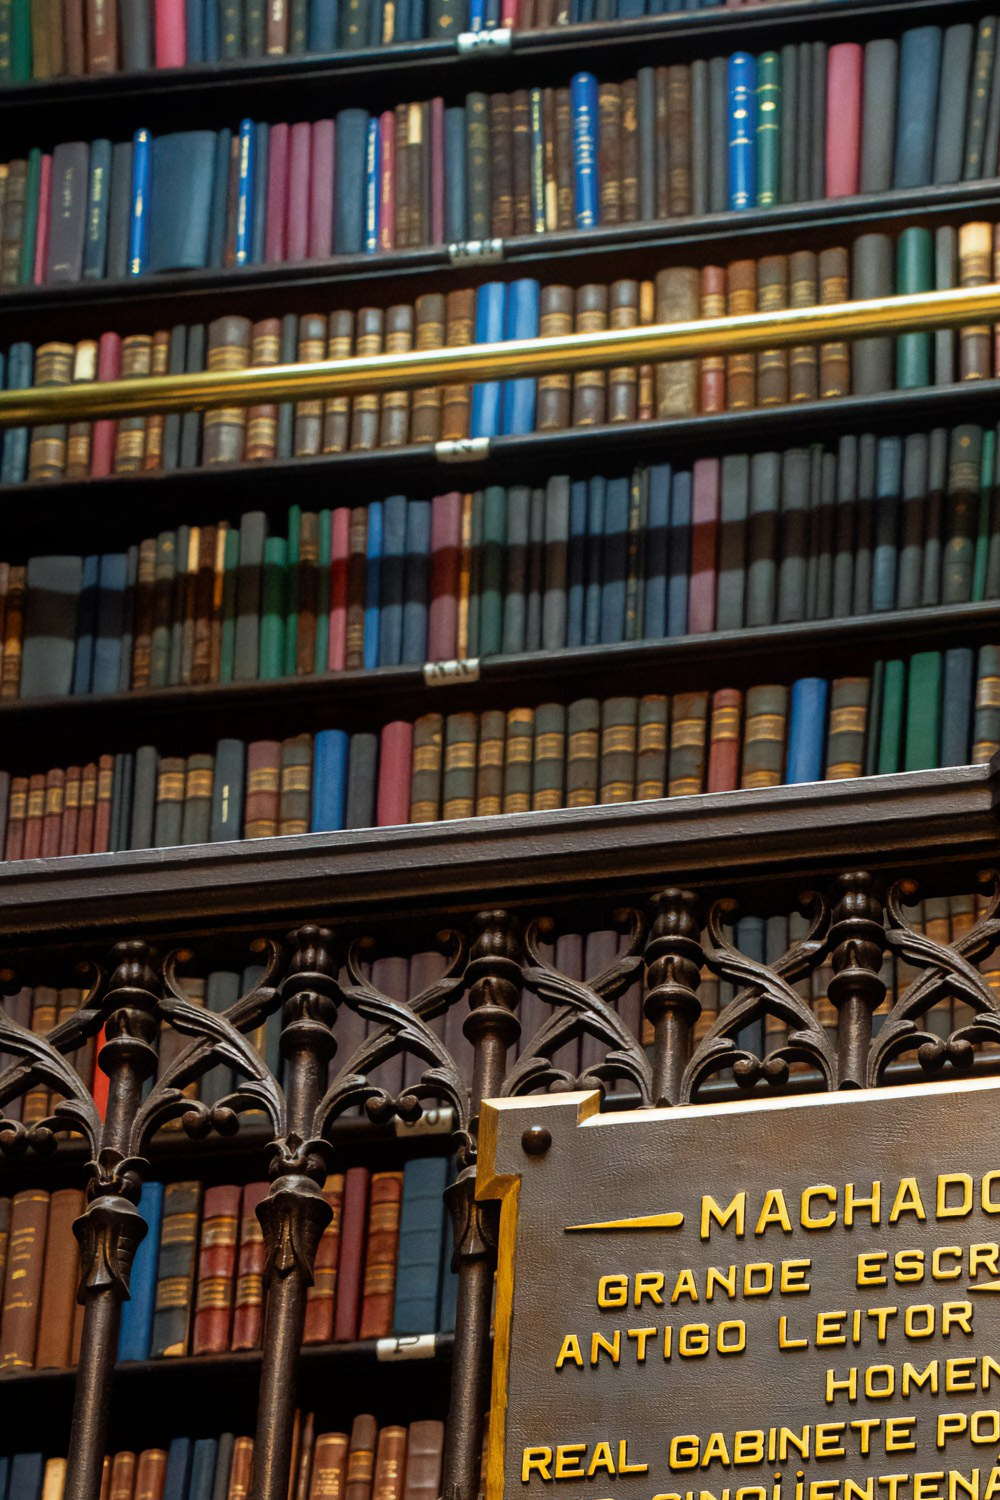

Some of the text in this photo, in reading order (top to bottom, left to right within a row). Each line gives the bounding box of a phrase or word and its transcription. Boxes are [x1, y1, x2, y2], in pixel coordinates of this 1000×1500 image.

[597, 1258, 811, 1308] GRANDE
[555, 1319, 747, 1368] ANTIGO
[778, 1302, 973, 1348] LEITOR
[521, 1440, 649, 1482] REAL
[669, 1417, 916, 1469] GABINETE
